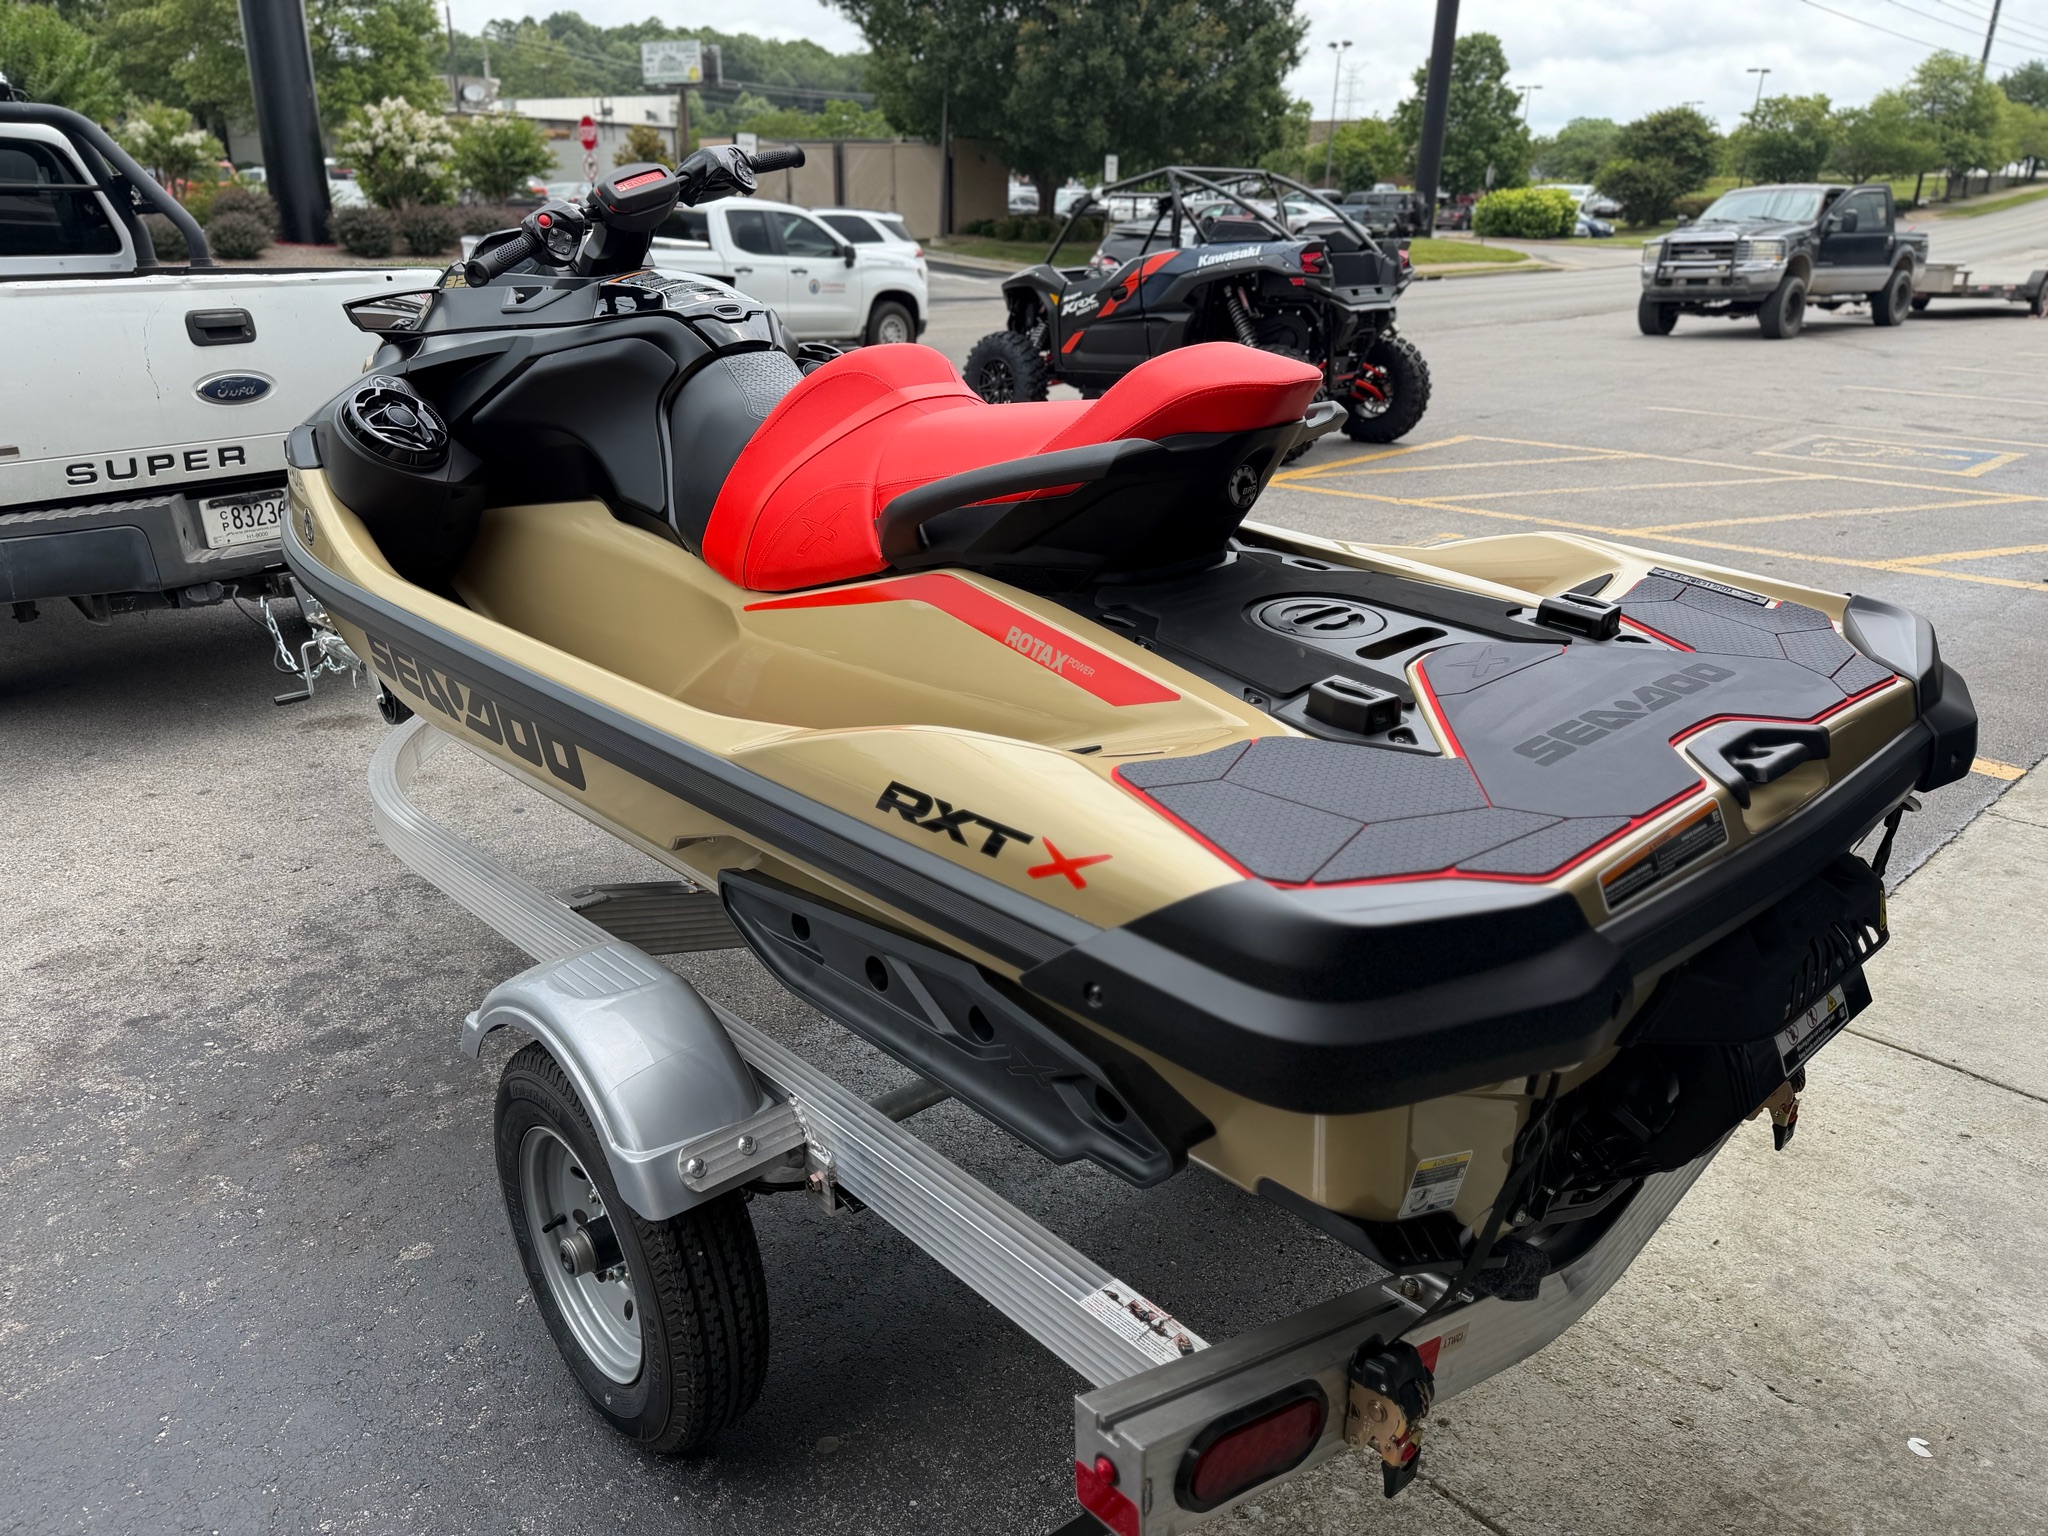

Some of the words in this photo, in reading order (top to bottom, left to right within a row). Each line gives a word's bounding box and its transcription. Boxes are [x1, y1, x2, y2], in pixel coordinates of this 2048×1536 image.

[1198, 245, 1261, 267] Kawasaki
[444, 275, 468, 288] 32
[1061, 293, 1098, 316] KRX
[217, 379, 257, 398] Ford
[66, 446, 246, 485] SUPER
[1004, 625, 1069, 673] ROTAX
[1066, 657, 1095, 677] POWER
[875, 780, 1035, 859] RXT
[1026, 836, 1113, 890] X
